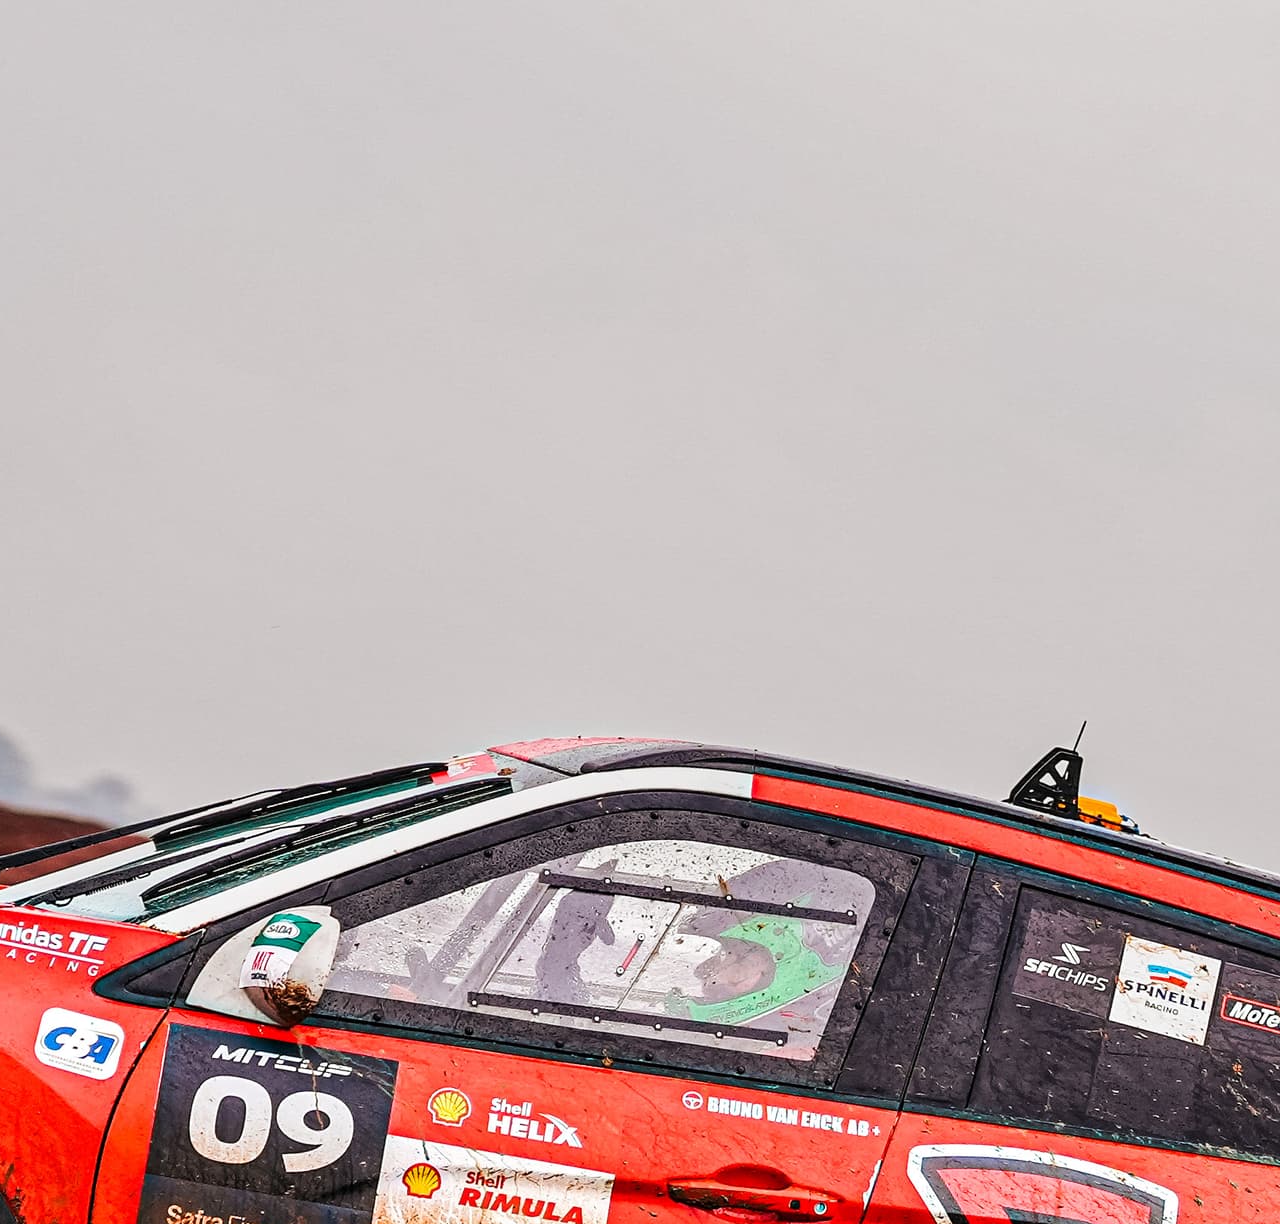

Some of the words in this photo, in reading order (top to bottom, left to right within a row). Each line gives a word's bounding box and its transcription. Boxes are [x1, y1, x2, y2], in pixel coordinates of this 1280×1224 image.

[69, 931, 109, 956] TF
[267, 925, 293, 935] SADA
[251, 951, 275, 971] MIT
[1023, 957, 1110, 992] SFICHIPS
[1124, 979, 1206, 1012] SPINELLI
[1144, 1001, 1179, 1016] RACING
[43, 1026, 116, 1065] CBA
[211, 1044, 353, 1078] MITCUP
[491, 1097, 533, 1117] Shell
[707, 1096, 763, 1120] BRUNO
[766, 1105, 799, 1126] VAN
[801, 1111, 844, 1133] ENCK
[189, 1075, 354, 1173] 09
[487, 1112, 583, 1148] HELIX
[465, 1171, 505, 1190] Shell
